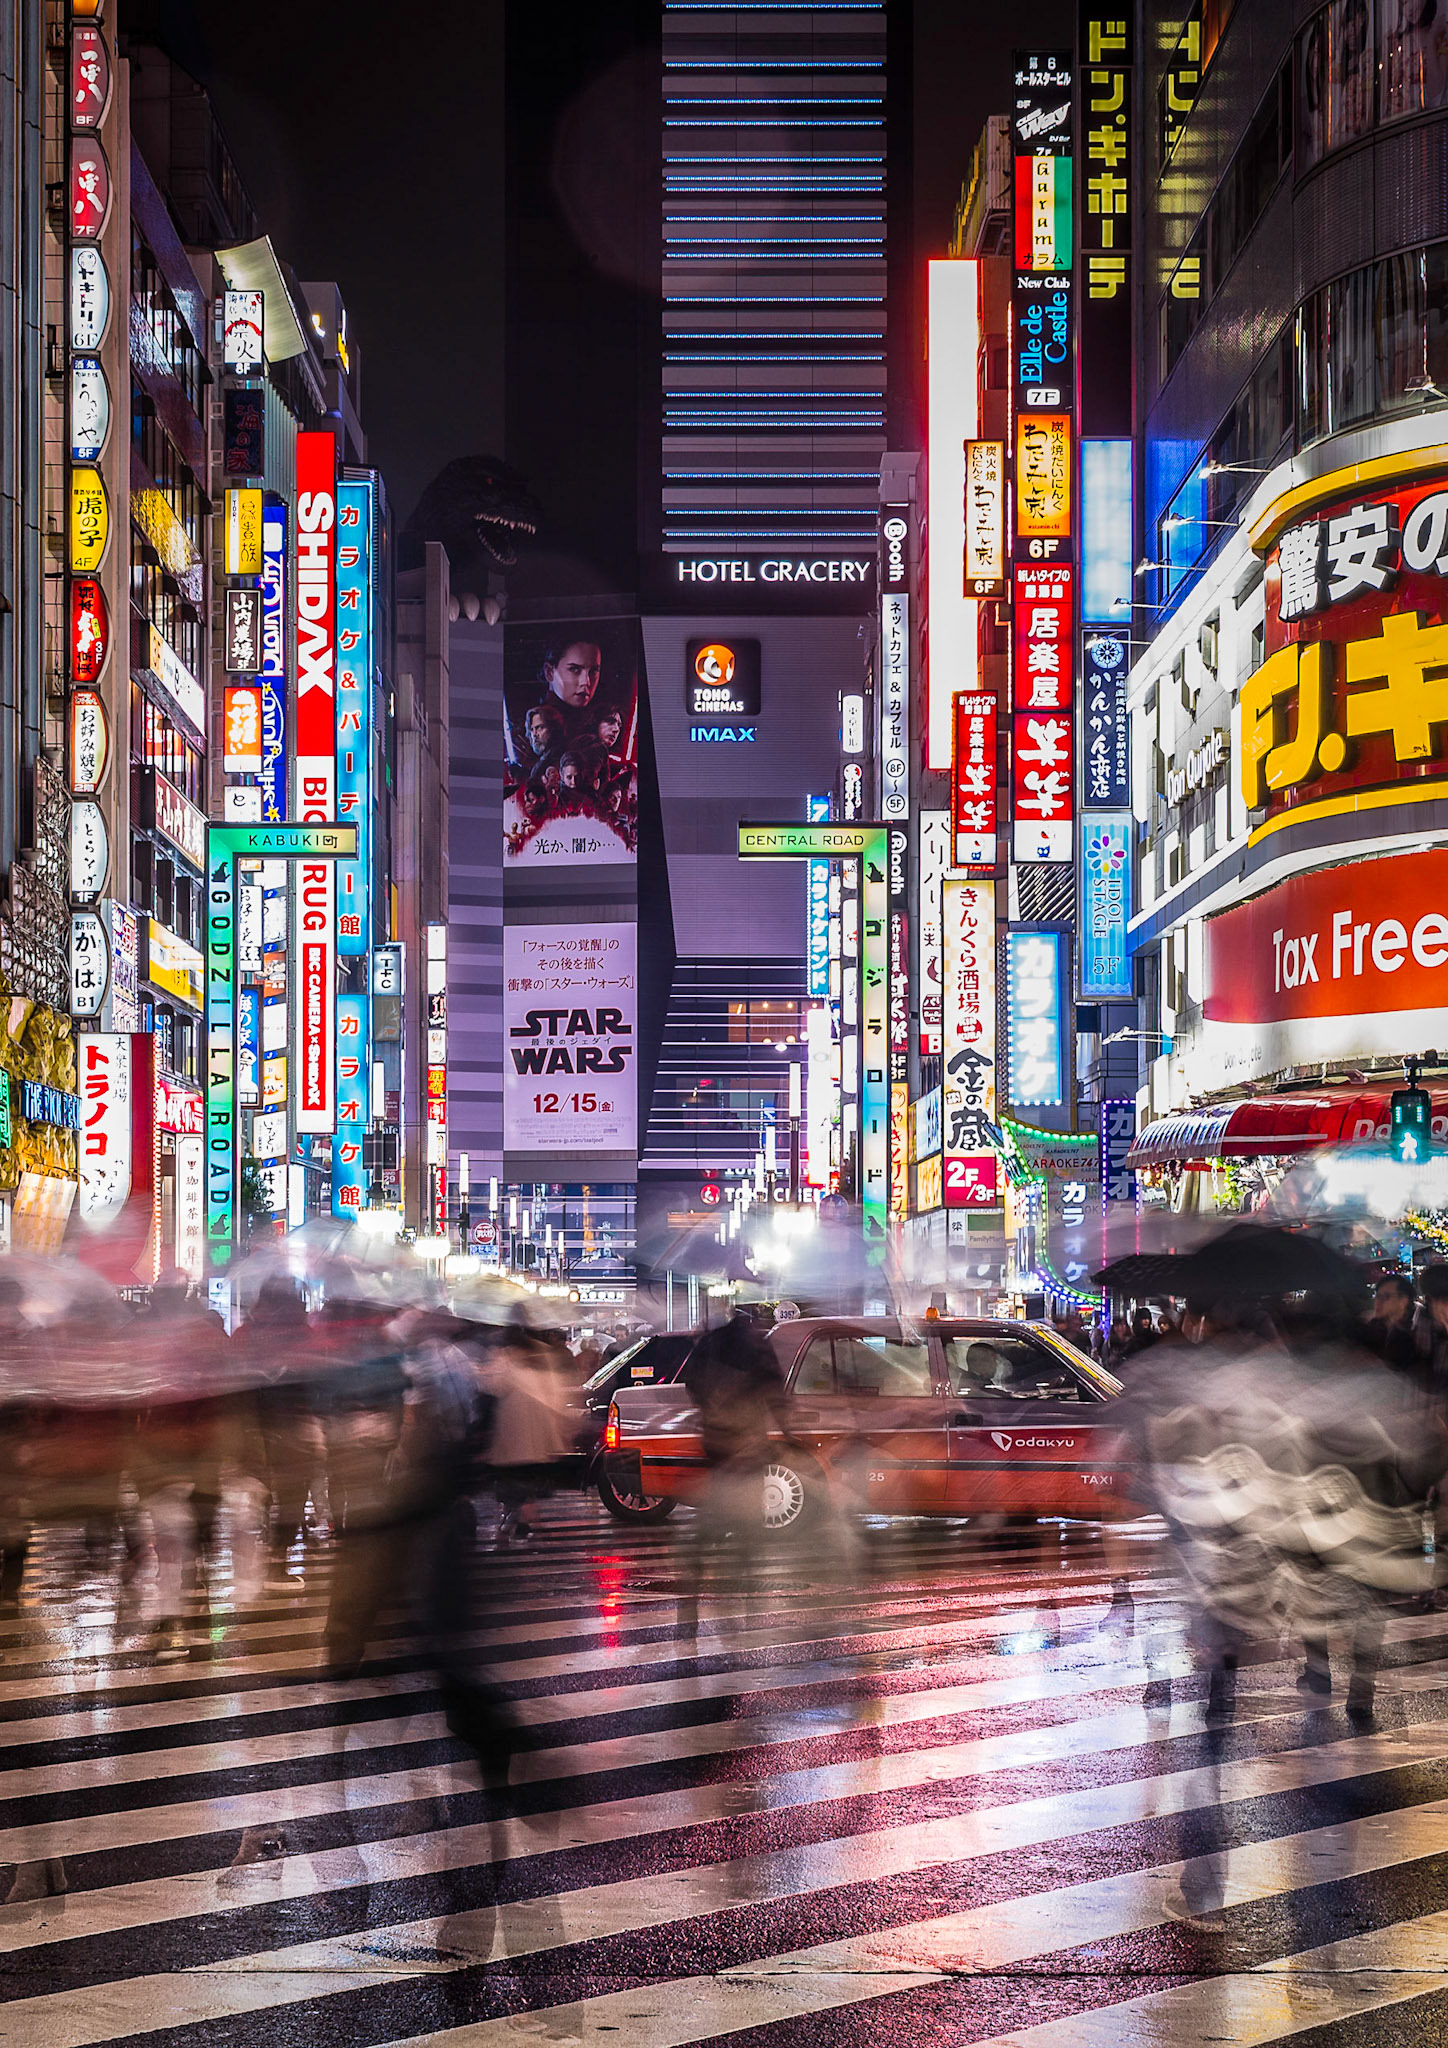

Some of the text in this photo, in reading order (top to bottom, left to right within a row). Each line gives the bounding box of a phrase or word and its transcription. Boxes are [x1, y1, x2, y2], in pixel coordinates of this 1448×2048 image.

[1016, 100, 1032, 109] 8F
[76, 115, 94, 124] 8F
[1035, 162, 1053, 245] Garam
[75, 225, 95, 235] 7F
[1017, 277, 1070, 289] New Club
[74, 332, 98, 347] 6F
[1044, 291, 1068, 364] Castle
[1019, 304, 1042, 385] Elle de
[235, 363, 251, 374] 8F
[1031, 391, 1057, 403] 7F
[78, 448, 94, 457] 5F
[986, 446, 997, 481] 炭火焼
[1024, 423, 1048, 519] わたみん家
[76, 497, 103, 548] 虎の子
[974, 485, 995, 566] わたみん家
[75, 557, 93, 567] 4F
[883, 518, 906, 583] Booth
[1029, 539, 1060, 559] 6F
[1278, 491, 1448, 622] 驚安の
[679, 561, 870, 581] HOTEL GRACERY
[1017, 570, 1071, 583] 新しいタイプの
[297, 491, 335, 698] SHIDAX
[974, 580, 996, 594] 6F
[231, 593, 255, 661] 山内農場
[890, 601, 903, 674] ネットカフェ
[236, 660, 249, 669] 5F
[1028, 607, 1061, 707] 居楽屋
[694, 689, 731, 701] TOHO
[890, 682, 902, 693] &
[694, 701, 744, 712] CINEMAS
[339, 504, 362, 937] カラオケ&パーテー館
[79, 709, 95, 782] お好み焼き
[690, 727, 756, 742] IMAX
[1089, 672, 1113, 799] かんかん商店
[1168, 732, 1226, 809] Don Quijote
[249, 835, 337, 848] KABUKI町
[533, 837, 617, 855] 光か、闇か…
[745, 835, 865, 847] CENTRAL ROAD
[76, 892, 94, 903] 1F
[303, 862, 326, 931] RUG
[1093, 879, 1107, 938] STAGE
[1108, 879, 1121, 928] IDOL
[74, 921, 96, 931] 新宿
[811, 865, 829, 990] カラオケランド
[523, 938, 620, 954] 「フォースの覚醒」の
[957, 888, 979, 1014] きんくら酒場
[1272, 910, 1448, 994] Tax Free
[308, 947, 322, 974] BIC
[537, 957, 604, 971] その後を描く
[1093, 955, 1122, 975] 5F
[507, 976, 635, 993] 衝撃の「スター・ウォーズ」
[77, 996, 95, 1008] B1
[510, 1008, 632, 1037] STAR
[1015, 937, 1056, 1097] カラオケ
[210, 890, 231, 1204] GODZILLA ROAD
[531, 1037, 613, 1047] 最後のジェダイ
[865, 918, 886, 1185] ゴジラロード
[511, 1046, 633, 1075] WARS
[84, 1045, 109, 1156] トラノコ
[338, 1015, 361, 1206] カラオケ館
[947, 1047, 994, 1151] 金の蔵
[1352, 1118, 1392, 1143] Do
[946, 1160, 979, 1188] 2F
[1026, 1157, 1099, 1169] KARAOKE 747
[1061, 1181, 1089, 1284] カラオケ
[779, 1309, 795, 1319] 3357
[868, 1472, 885, 1482] 25
[1080, 1474, 1113, 1485] TAXI
